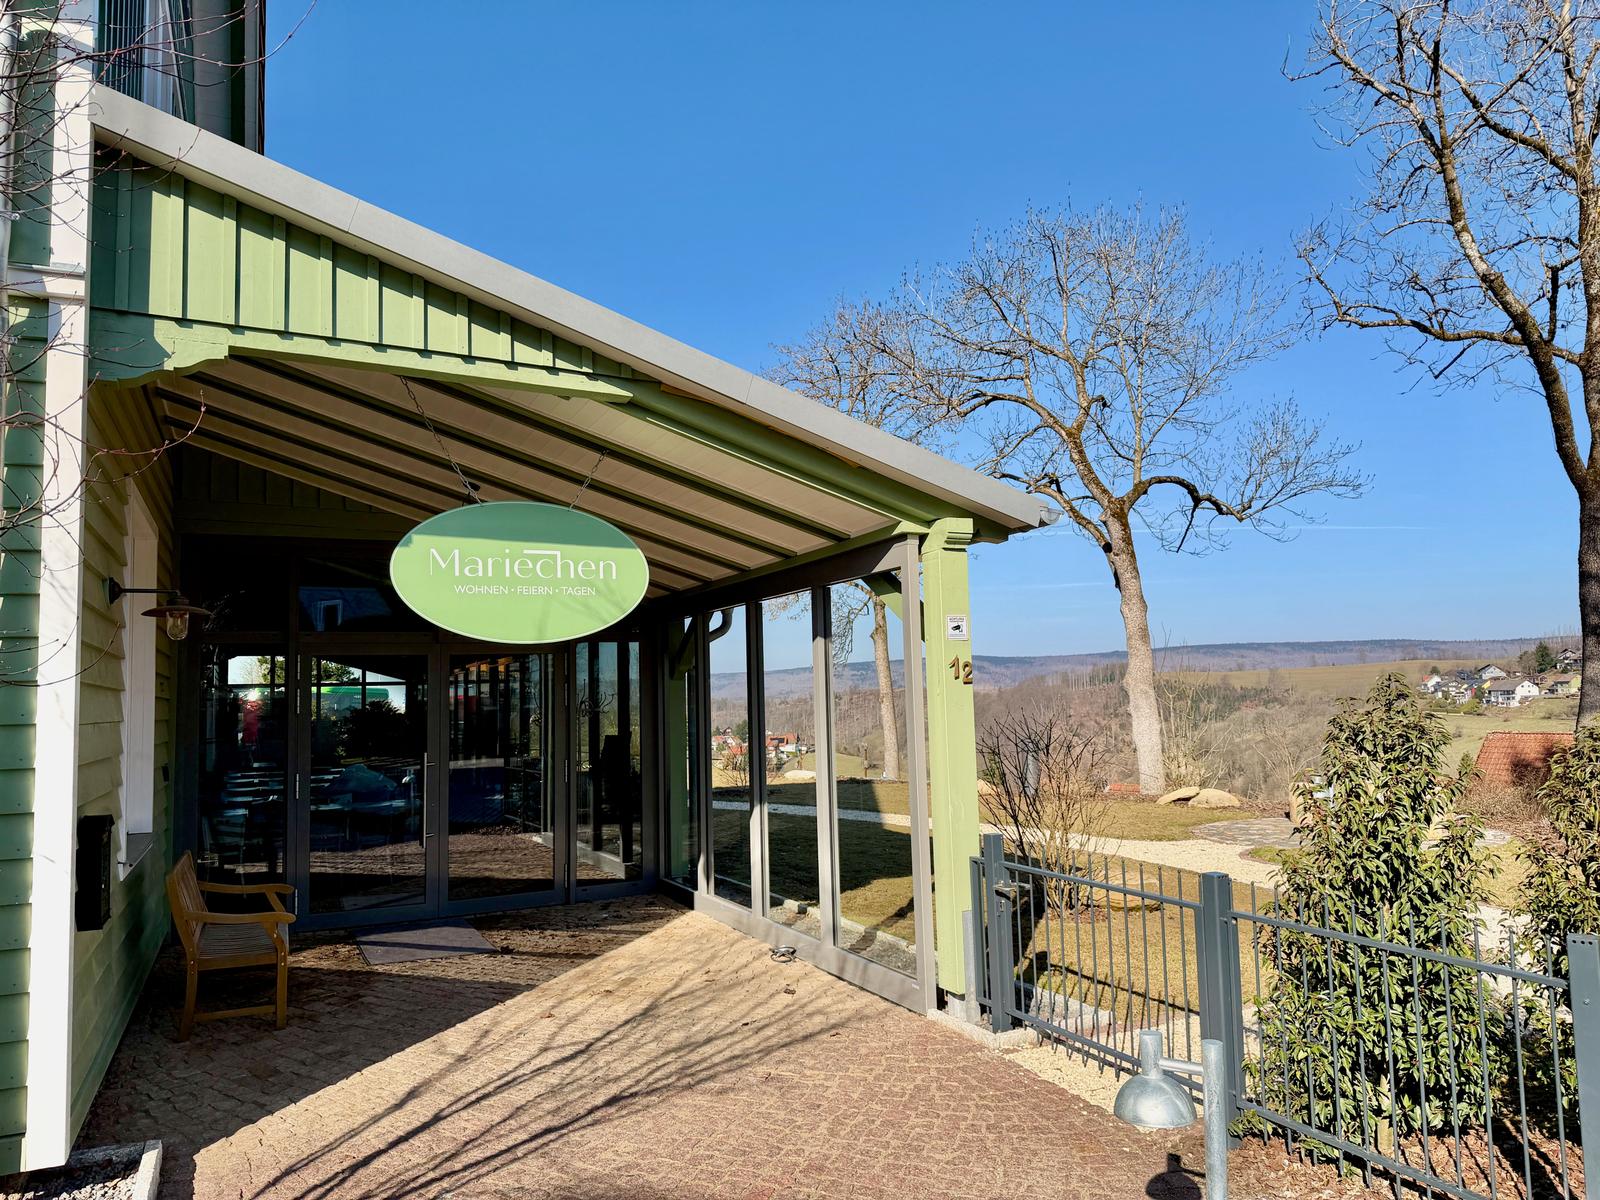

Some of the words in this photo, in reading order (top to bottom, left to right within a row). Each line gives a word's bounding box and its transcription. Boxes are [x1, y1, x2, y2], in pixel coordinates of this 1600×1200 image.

[429, 547, 617, 580] Mariechen
[454, 584, 508, 595] WOHNEN
[516, 585, 553, 596] FEIERN
[560, 586, 596, 597] TAGEN
[948, 655, 973, 685] 12
